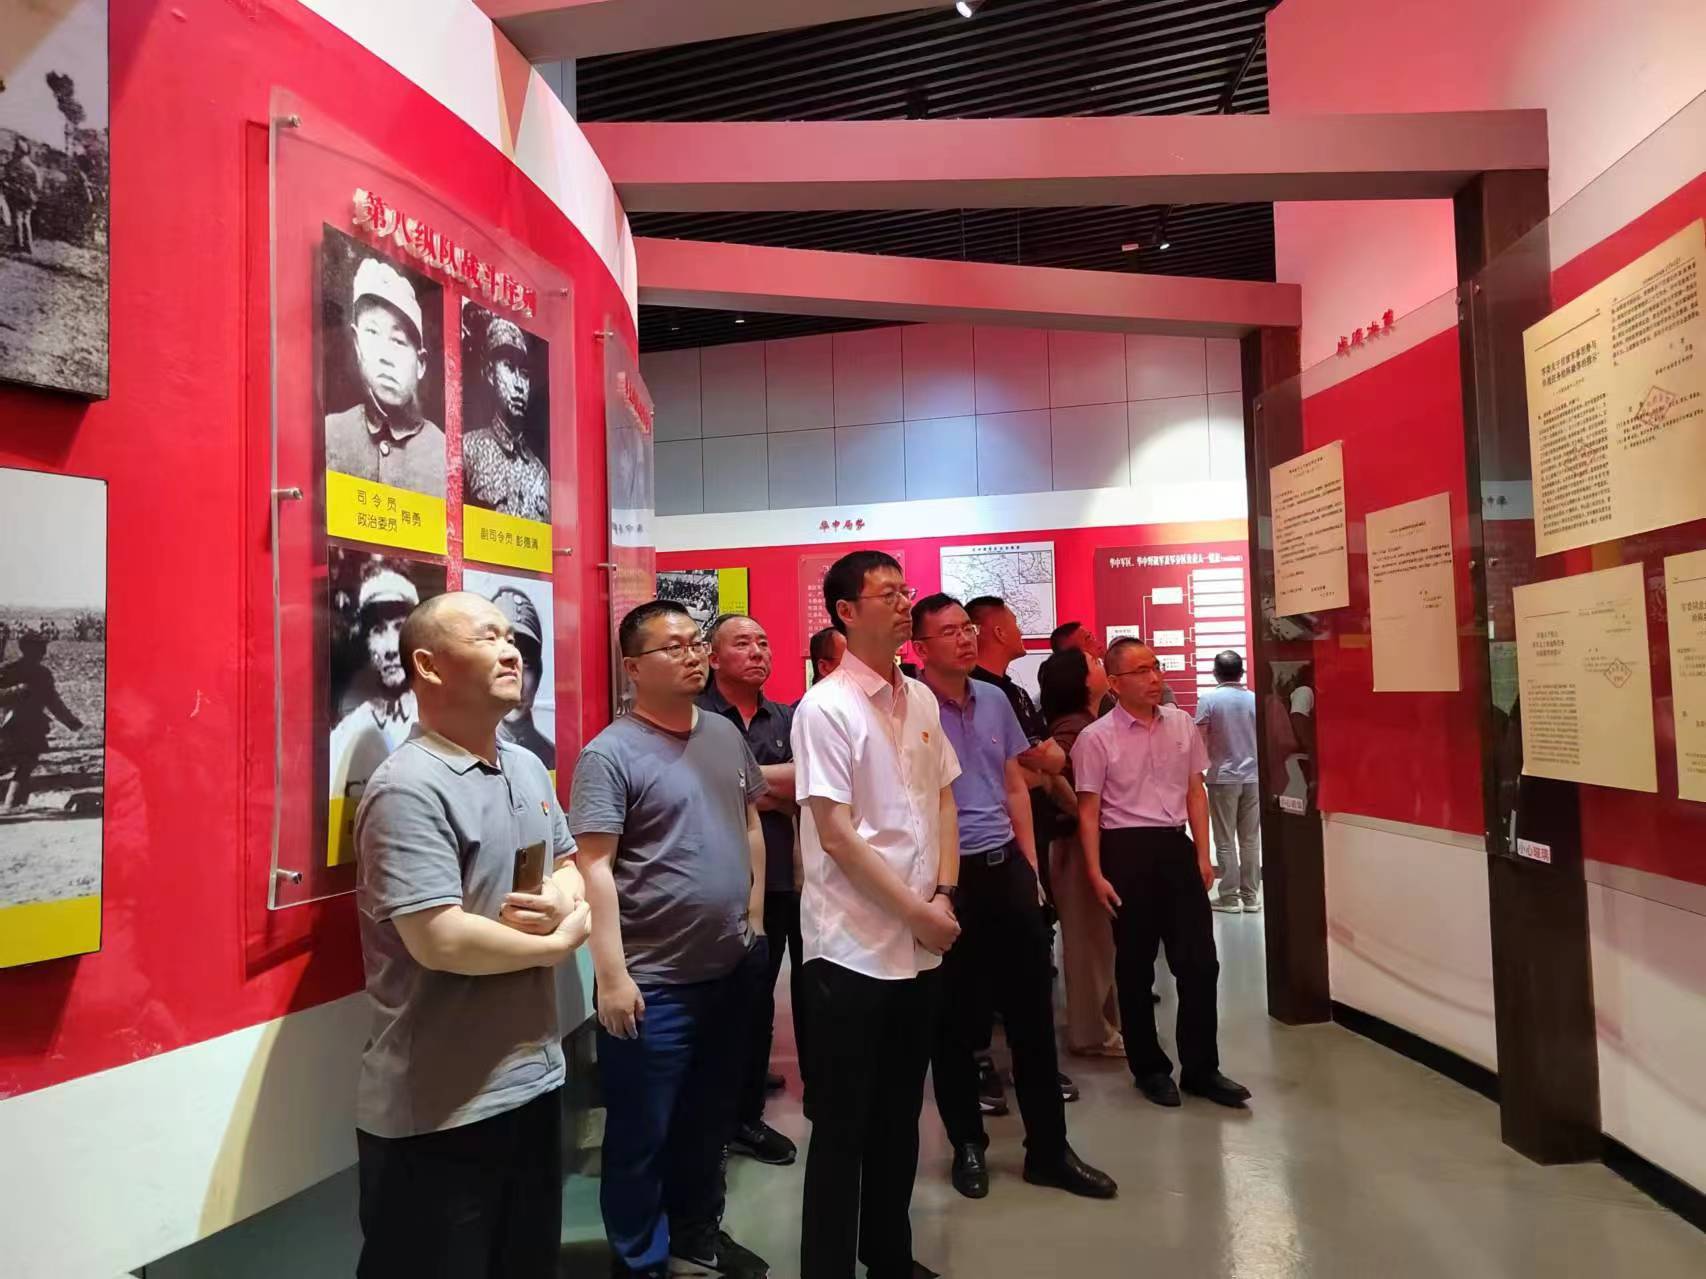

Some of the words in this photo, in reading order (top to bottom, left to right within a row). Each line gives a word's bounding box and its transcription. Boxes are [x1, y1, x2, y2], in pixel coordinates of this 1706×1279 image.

[357, 489, 397, 512] 司令员
[357, 512, 398, 533] 政治委员
[401, 509, 422, 527] 陶勇
[480, 527, 513, 545] 副司令员
